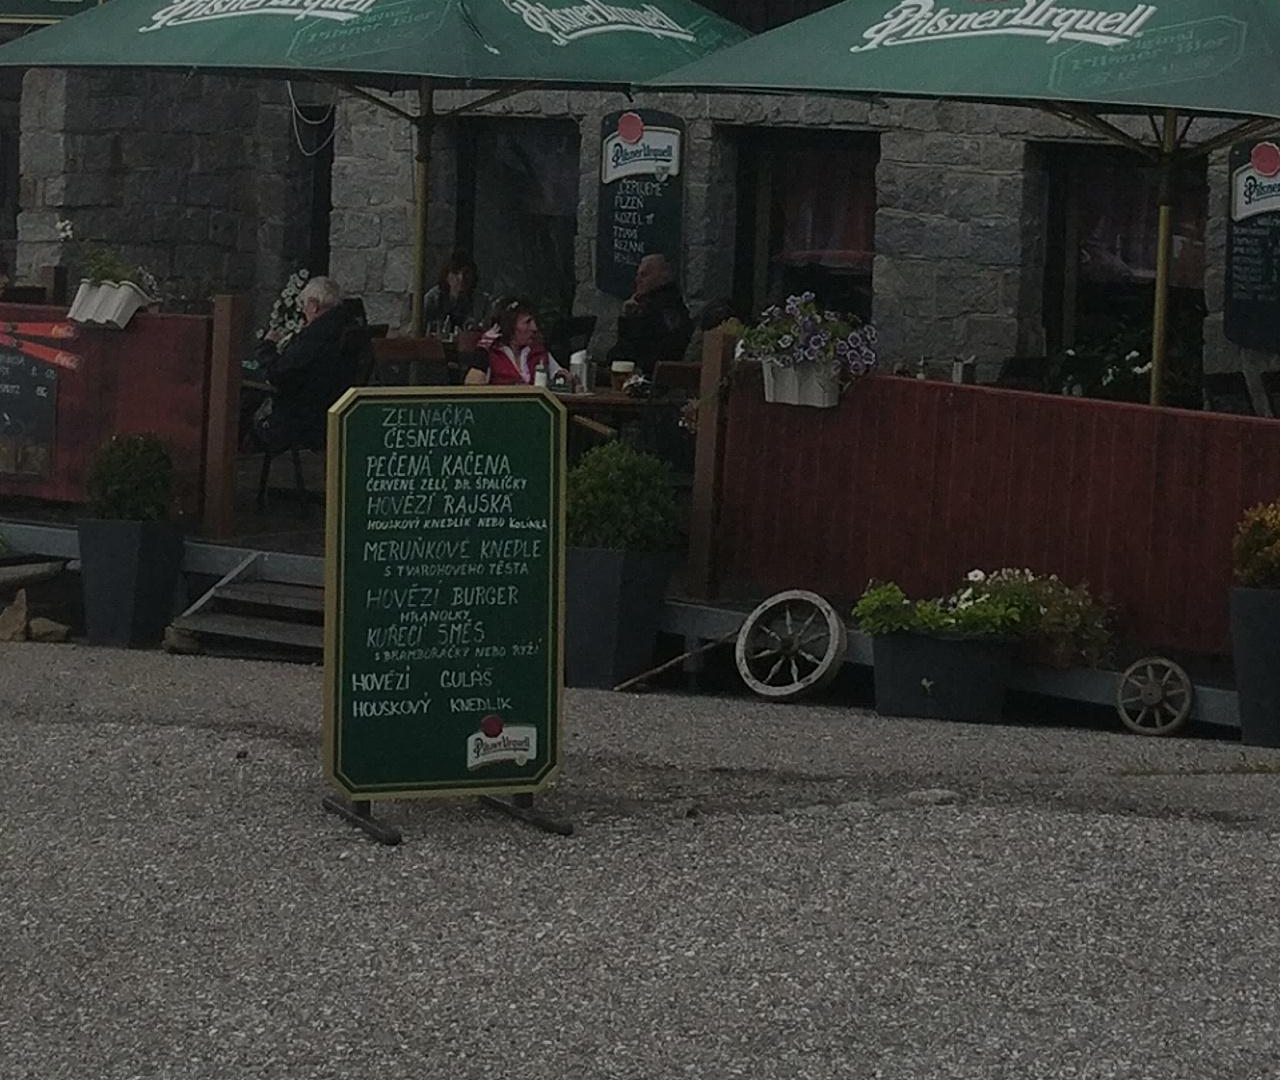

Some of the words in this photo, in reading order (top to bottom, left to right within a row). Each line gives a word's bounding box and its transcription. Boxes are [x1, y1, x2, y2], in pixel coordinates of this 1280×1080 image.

[366, 449, 433, 478] PEČENÁ
[440, 451, 512, 477] KAČENA
[450, 586, 520, 606] BURGER
[352, 692, 432, 718] HOUSKOVÝ
